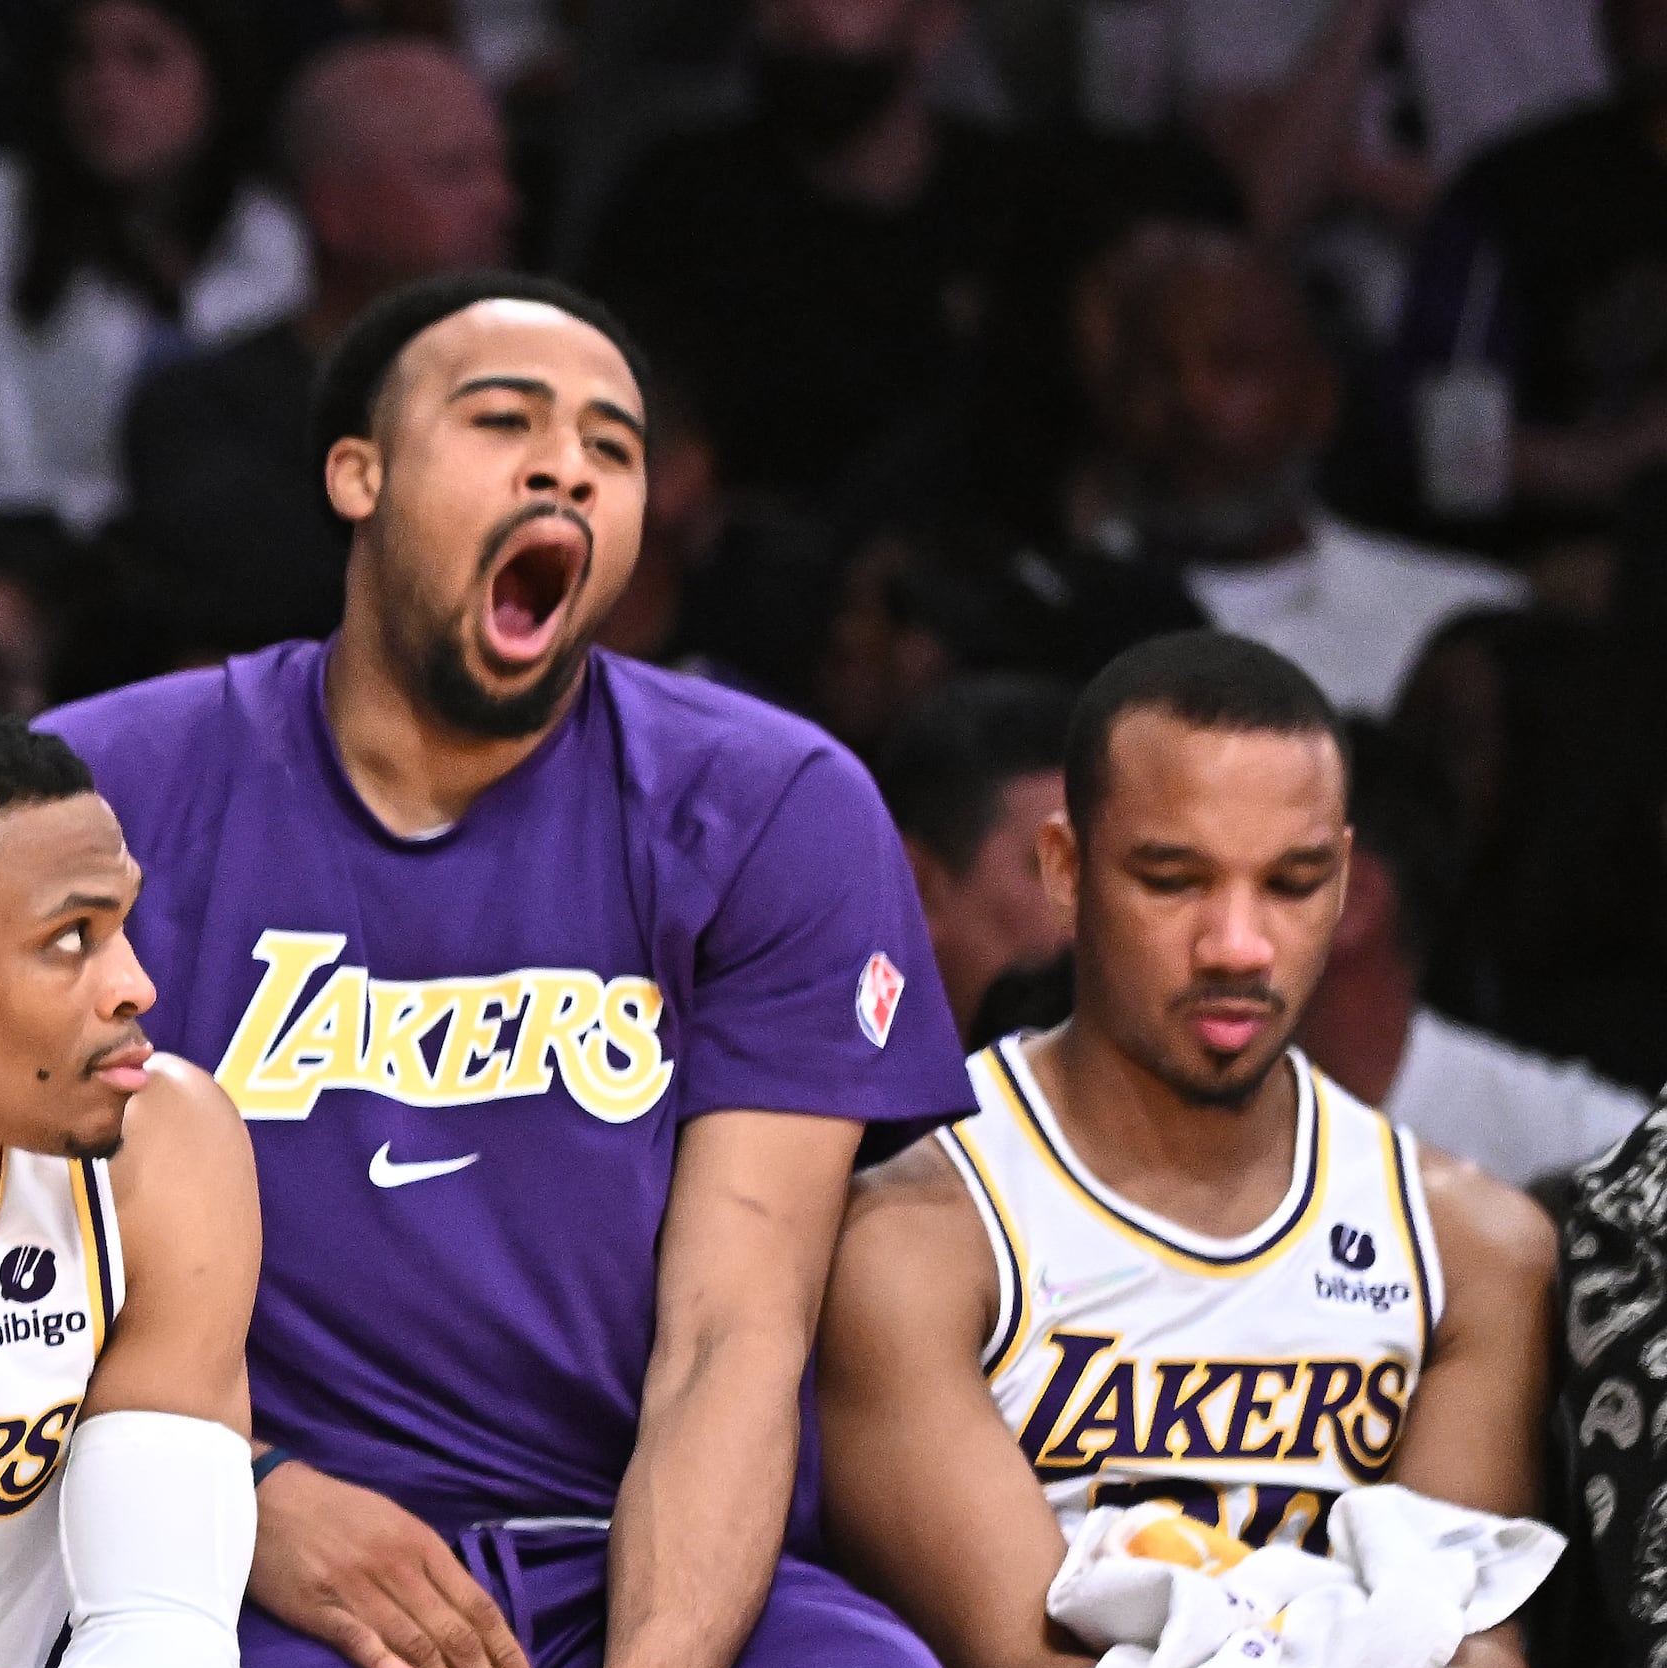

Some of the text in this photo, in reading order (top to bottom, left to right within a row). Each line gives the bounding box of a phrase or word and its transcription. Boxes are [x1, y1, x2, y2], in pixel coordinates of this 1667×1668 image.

[213, 928, 674, 1124] LAKERS
[1315, 1271, 1410, 1313] bibigo
[1017, 1328, 1409, 1485] LAKERS
